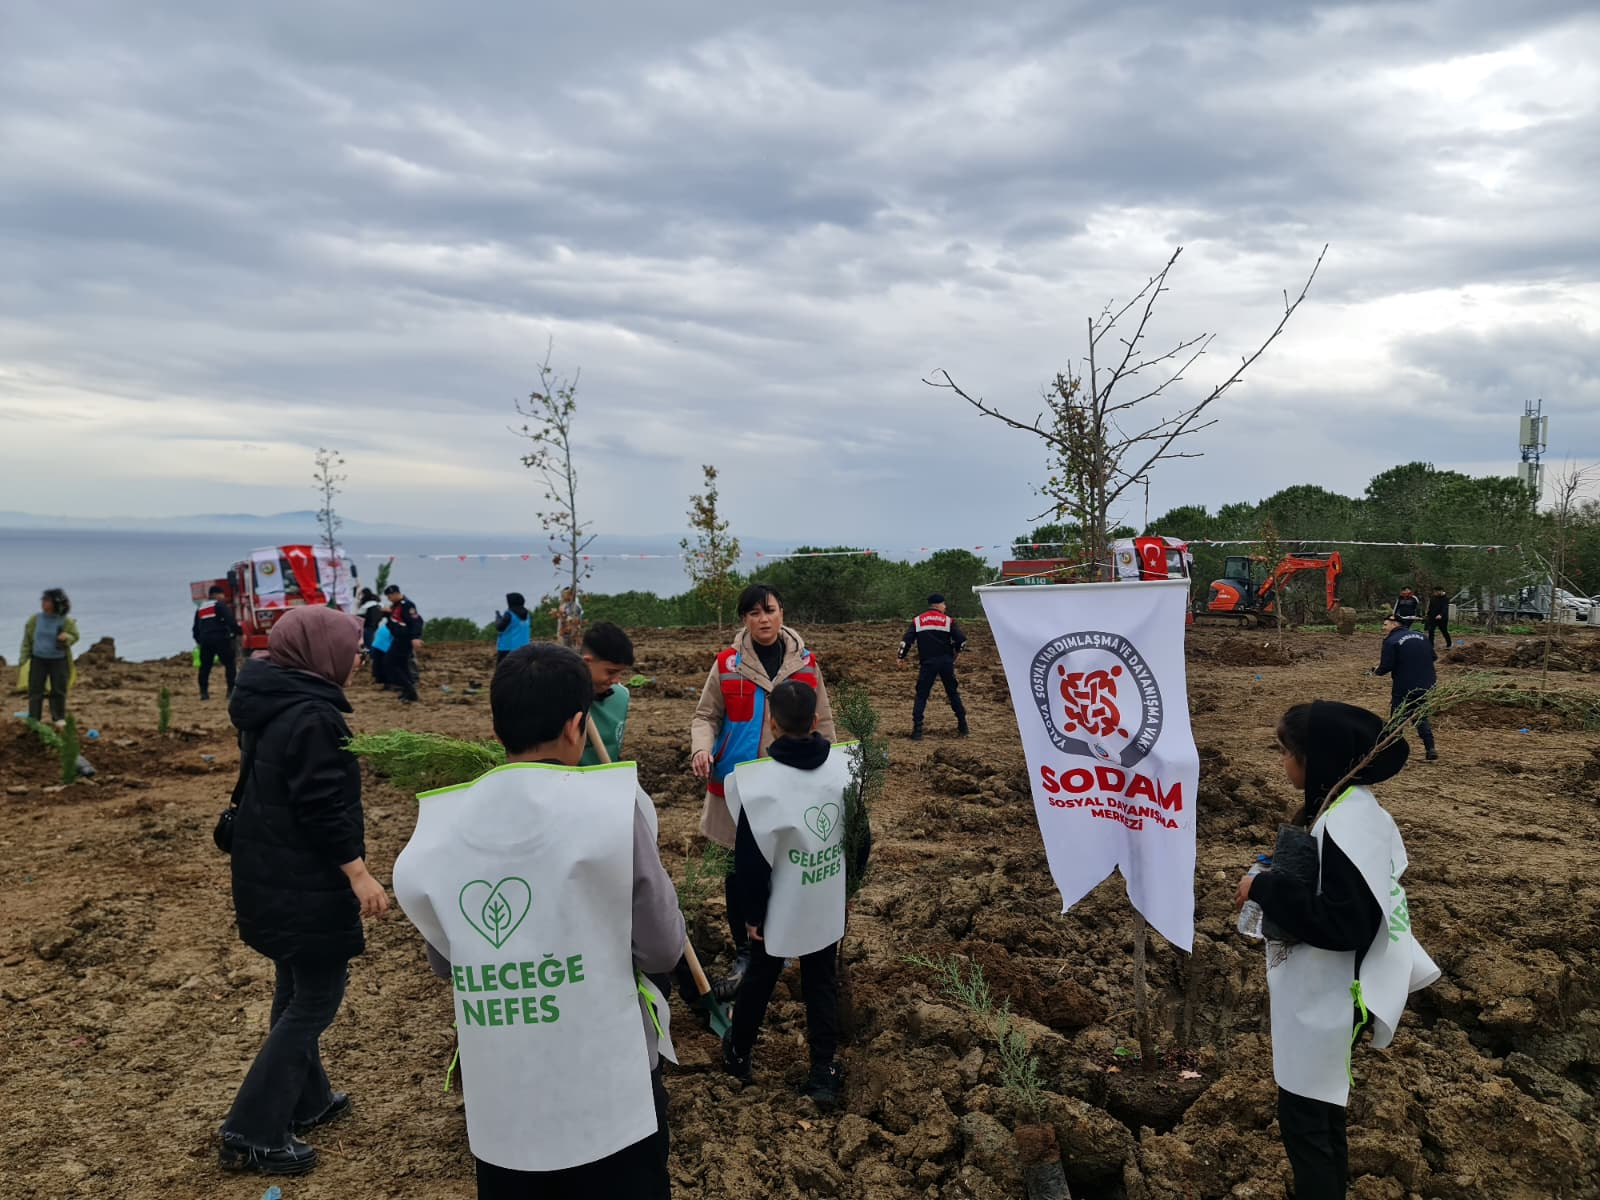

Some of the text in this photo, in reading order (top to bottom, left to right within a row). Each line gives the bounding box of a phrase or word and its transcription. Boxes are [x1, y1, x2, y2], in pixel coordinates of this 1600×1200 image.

[1039, 634, 1119, 663] YARDIMLAŞMA
[1119, 642, 1132, 659] VE
[1033, 663, 1047, 699] SOSYAL
[1128, 655, 1161, 725] DAYANIŞMA
[1040, 703, 1067, 749] YALOVA
[1040, 765, 1184, 812] SODAM
[1048, 796, 1179, 829] SOSYAL DAYANIŞMA
[1091, 808, 1143, 831] MERKEZİ
[453, 952, 585, 993] ELECEĞE
[462, 994, 560, 1027] NEFES
